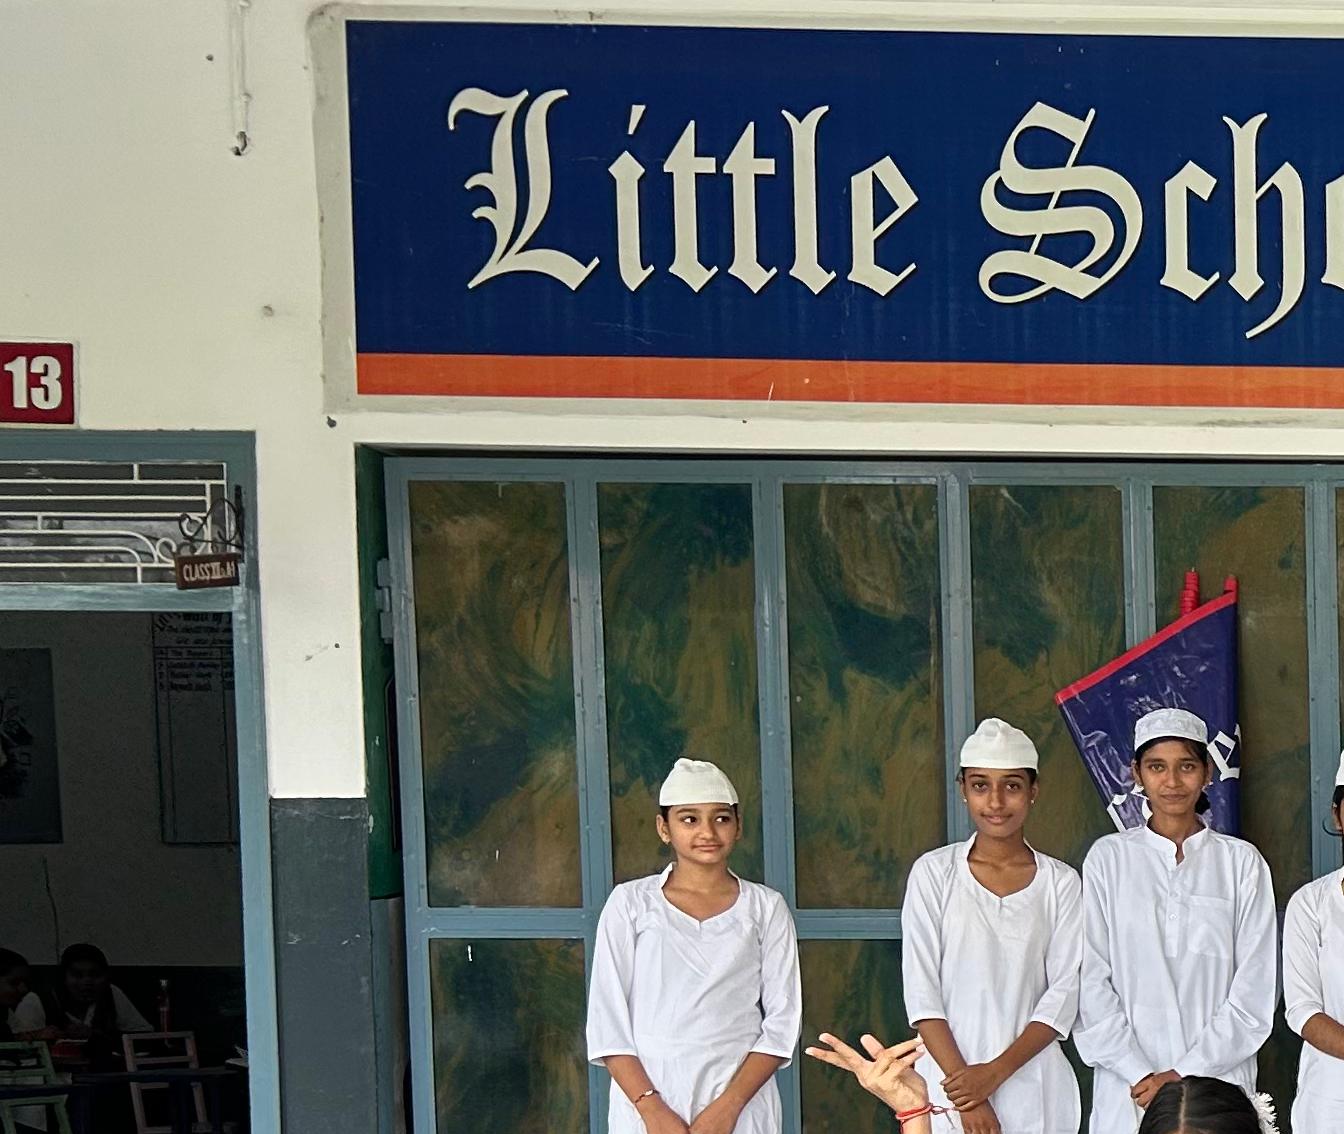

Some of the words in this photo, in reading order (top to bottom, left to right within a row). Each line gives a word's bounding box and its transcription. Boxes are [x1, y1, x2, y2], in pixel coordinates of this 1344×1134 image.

[447, 87, 919, 297] Little
[3, 355, 63, 410] 13
[183, 563, 210, 581] CLASS
